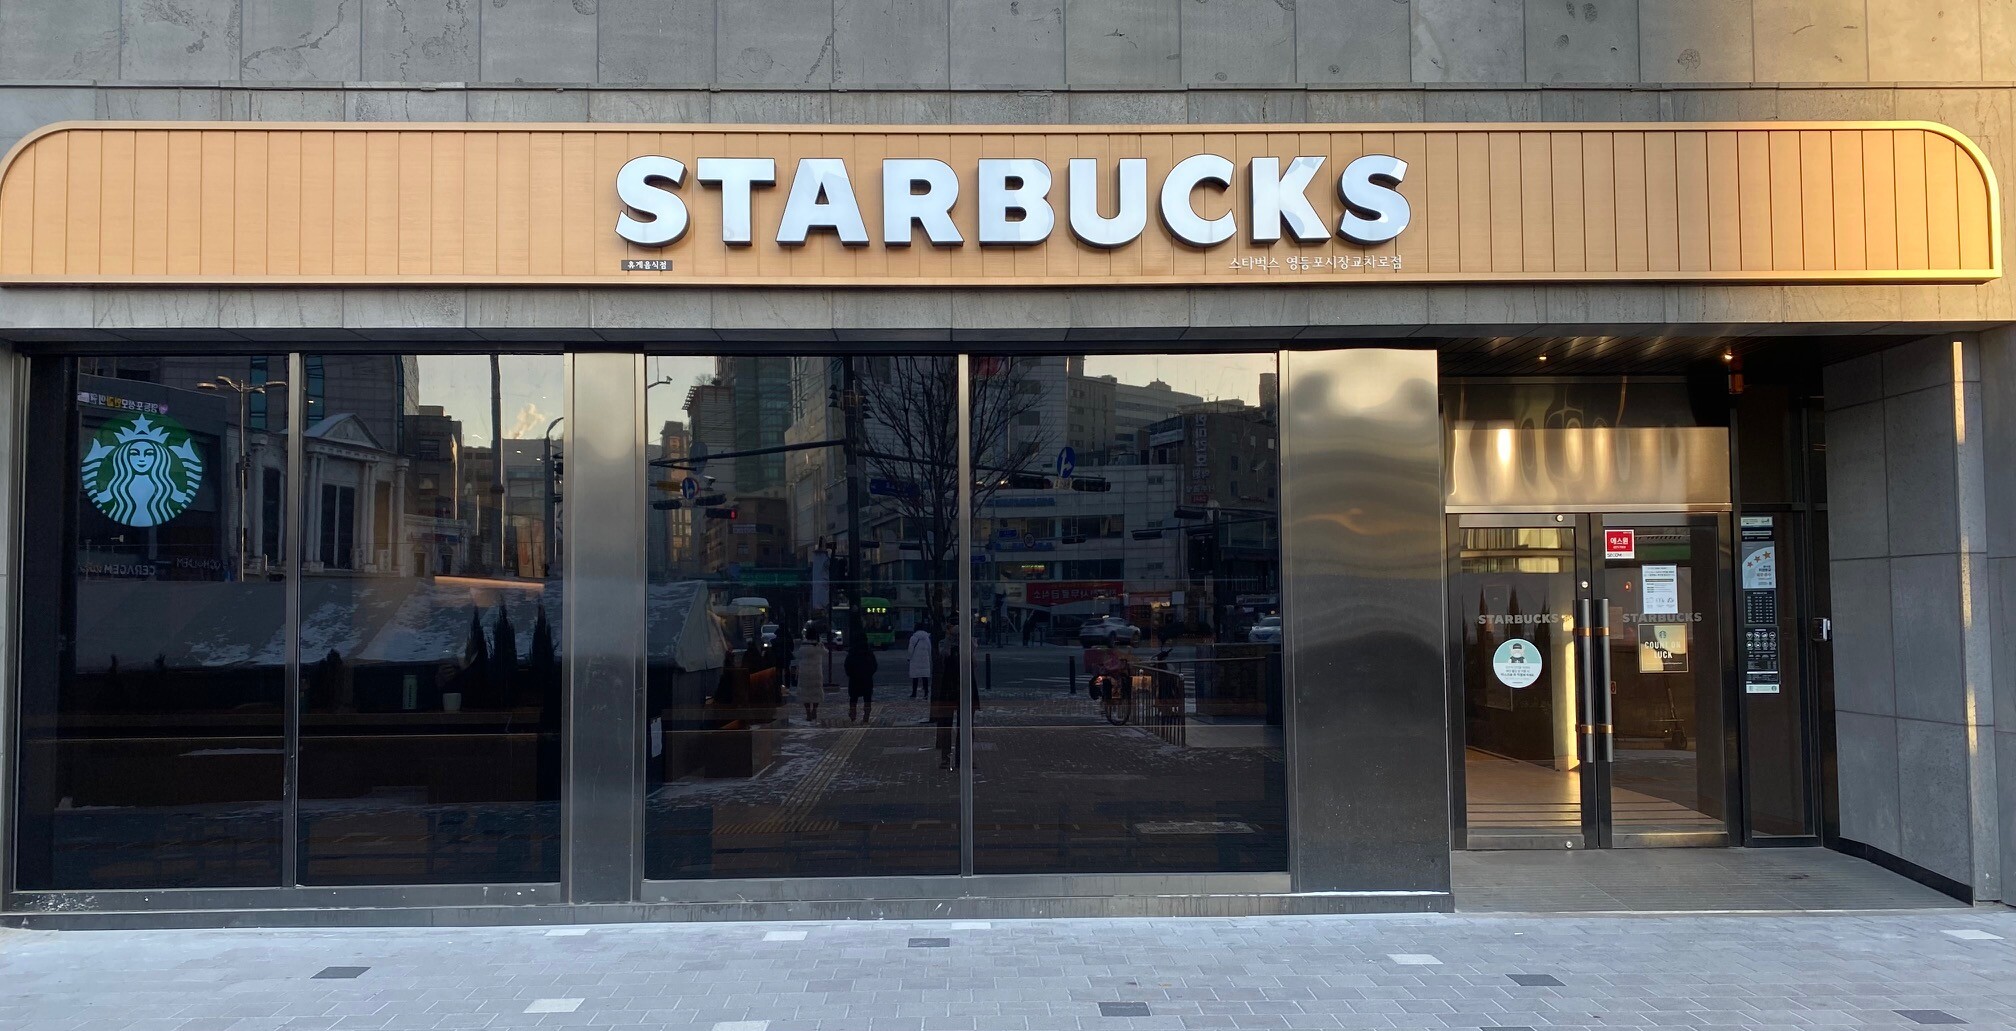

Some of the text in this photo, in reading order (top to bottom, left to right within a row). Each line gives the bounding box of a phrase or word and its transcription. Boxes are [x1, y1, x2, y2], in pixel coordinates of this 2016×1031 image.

[614, 154, 1412, 248] STARBUCKS
[627, 260, 667, 270] 휴게음식점
[1229, 254, 1403, 270] 스타벅스 영등포시장교차로점
[1610, 536, 1629, 545] 에스원
[1478, 613, 1559, 625] STARBUCKS
[1622, 612, 1703, 623] STARBUCKS
[1654, 650, 1673, 659] LUCK
